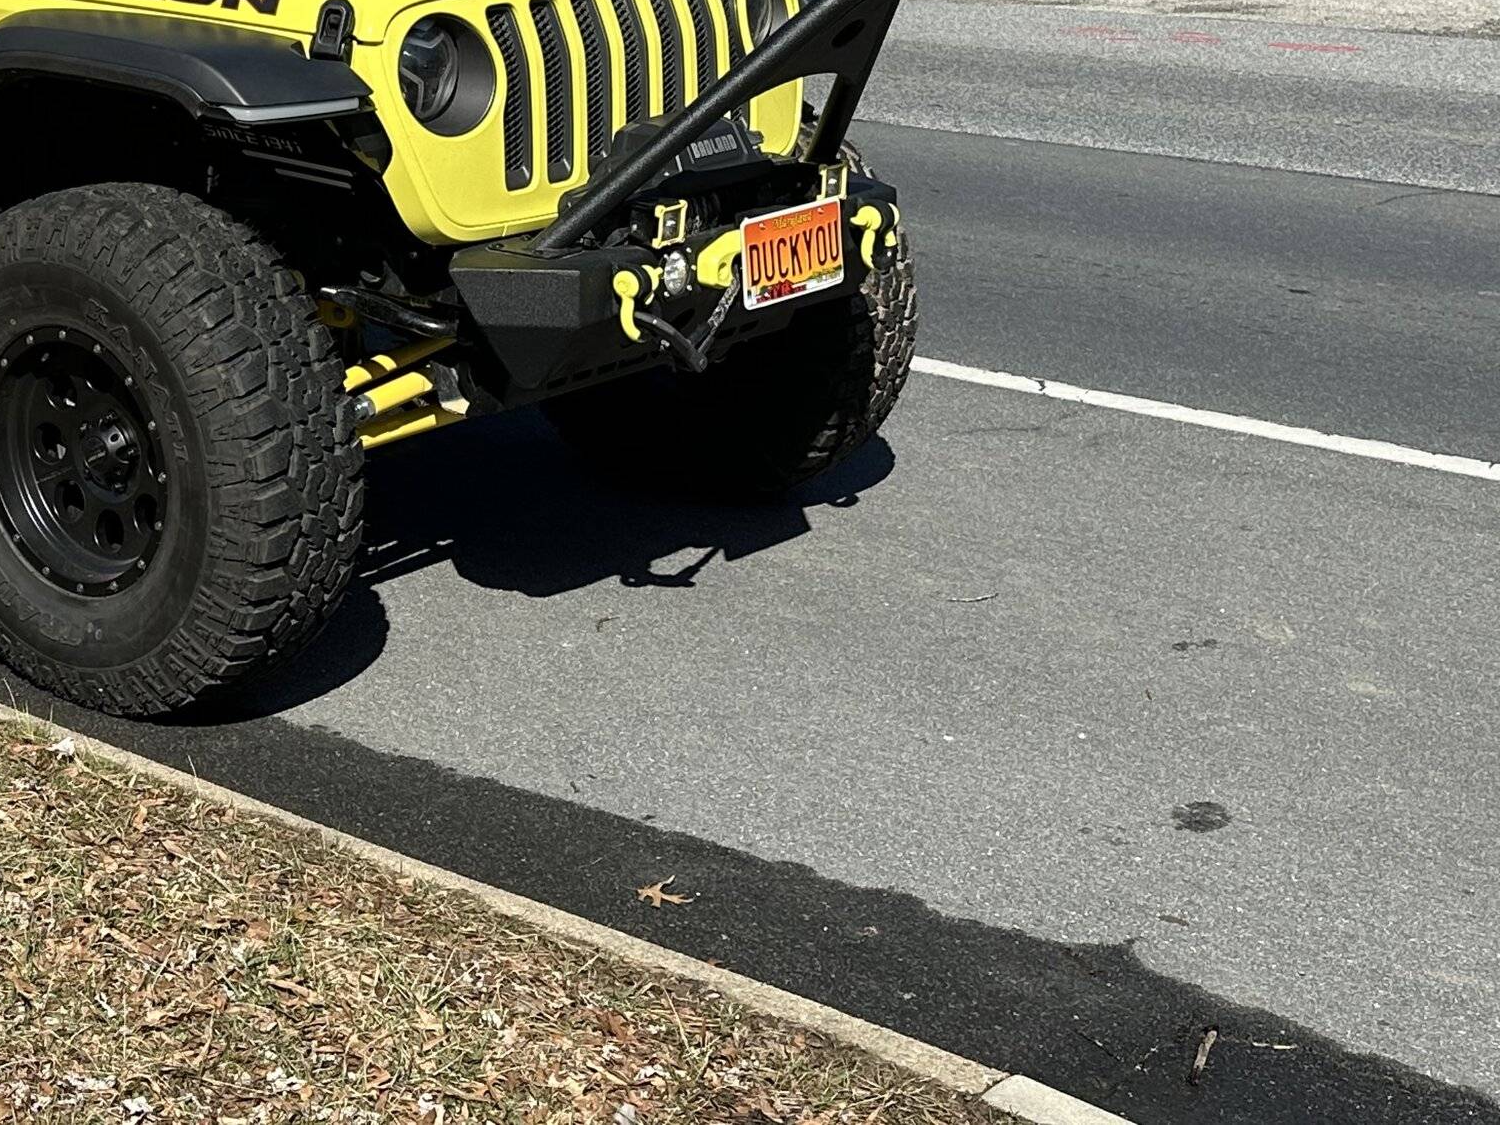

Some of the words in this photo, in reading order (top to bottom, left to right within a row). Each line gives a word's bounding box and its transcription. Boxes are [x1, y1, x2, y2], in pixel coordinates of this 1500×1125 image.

[690, 133, 737, 158] BADLAND
[748, 220, 840, 287] DUCKYOU
[84, 297, 190, 463] KANATI
